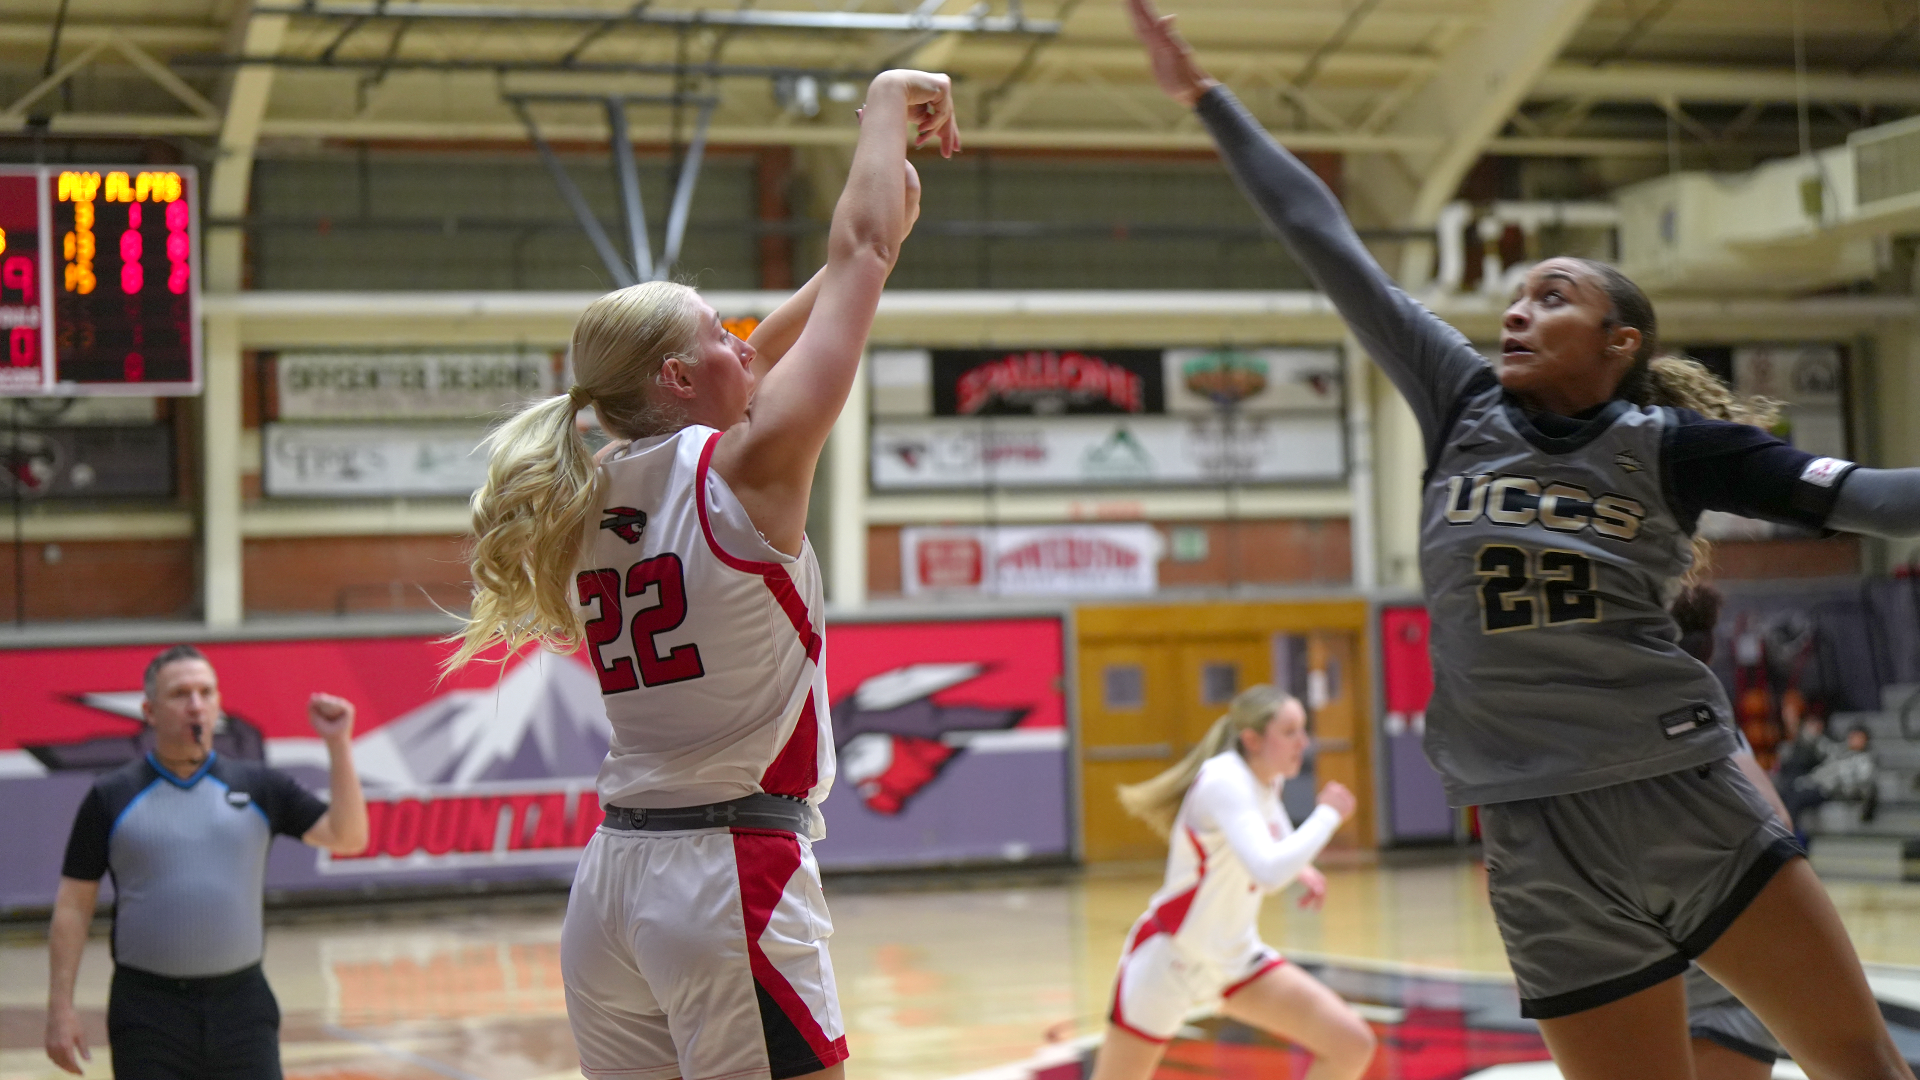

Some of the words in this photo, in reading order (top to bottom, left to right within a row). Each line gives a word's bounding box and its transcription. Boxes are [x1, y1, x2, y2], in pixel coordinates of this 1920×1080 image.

[0, 256, 34, 304] 9
[1443, 470, 1647, 542] UCCS
[576, 552, 705, 695] 22
[1475, 543, 1602, 635] 22
[332, 791, 605, 860] OUNTAI
